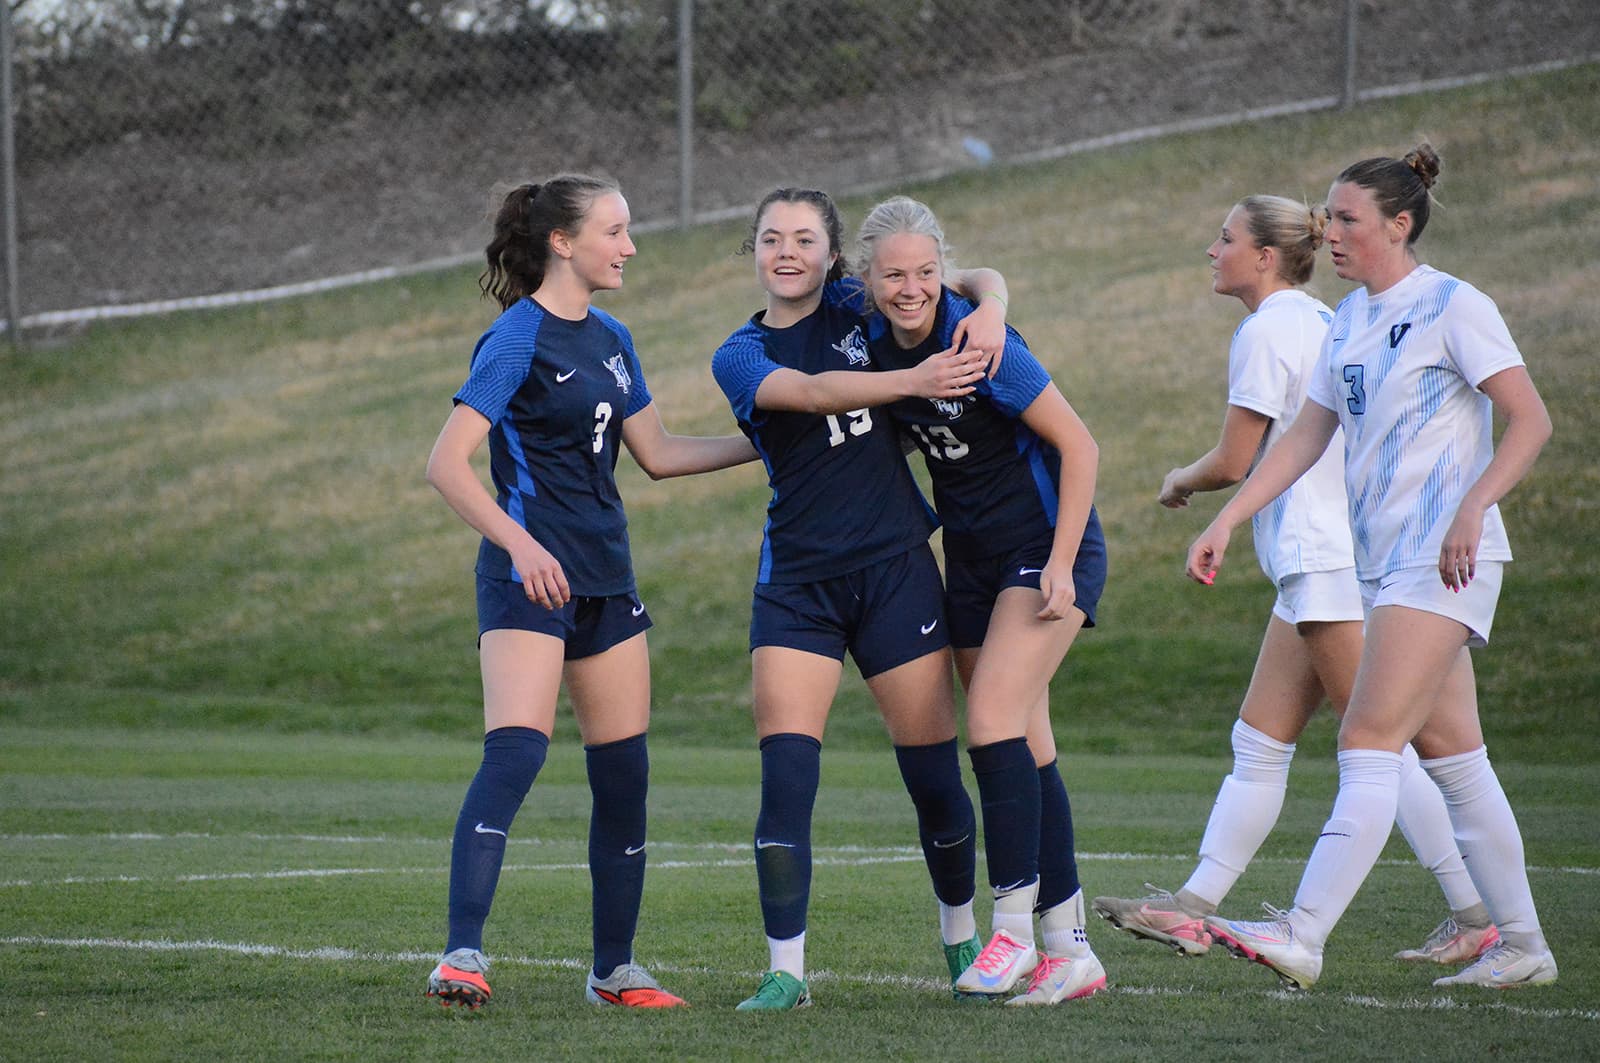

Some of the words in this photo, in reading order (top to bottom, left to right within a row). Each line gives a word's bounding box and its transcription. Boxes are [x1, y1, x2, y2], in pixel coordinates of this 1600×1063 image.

[1389, 322, 1412, 349] V
[1343, 364, 1367, 415] 3
[591, 402, 612, 453] 3
[912, 424, 970, 461] 13
